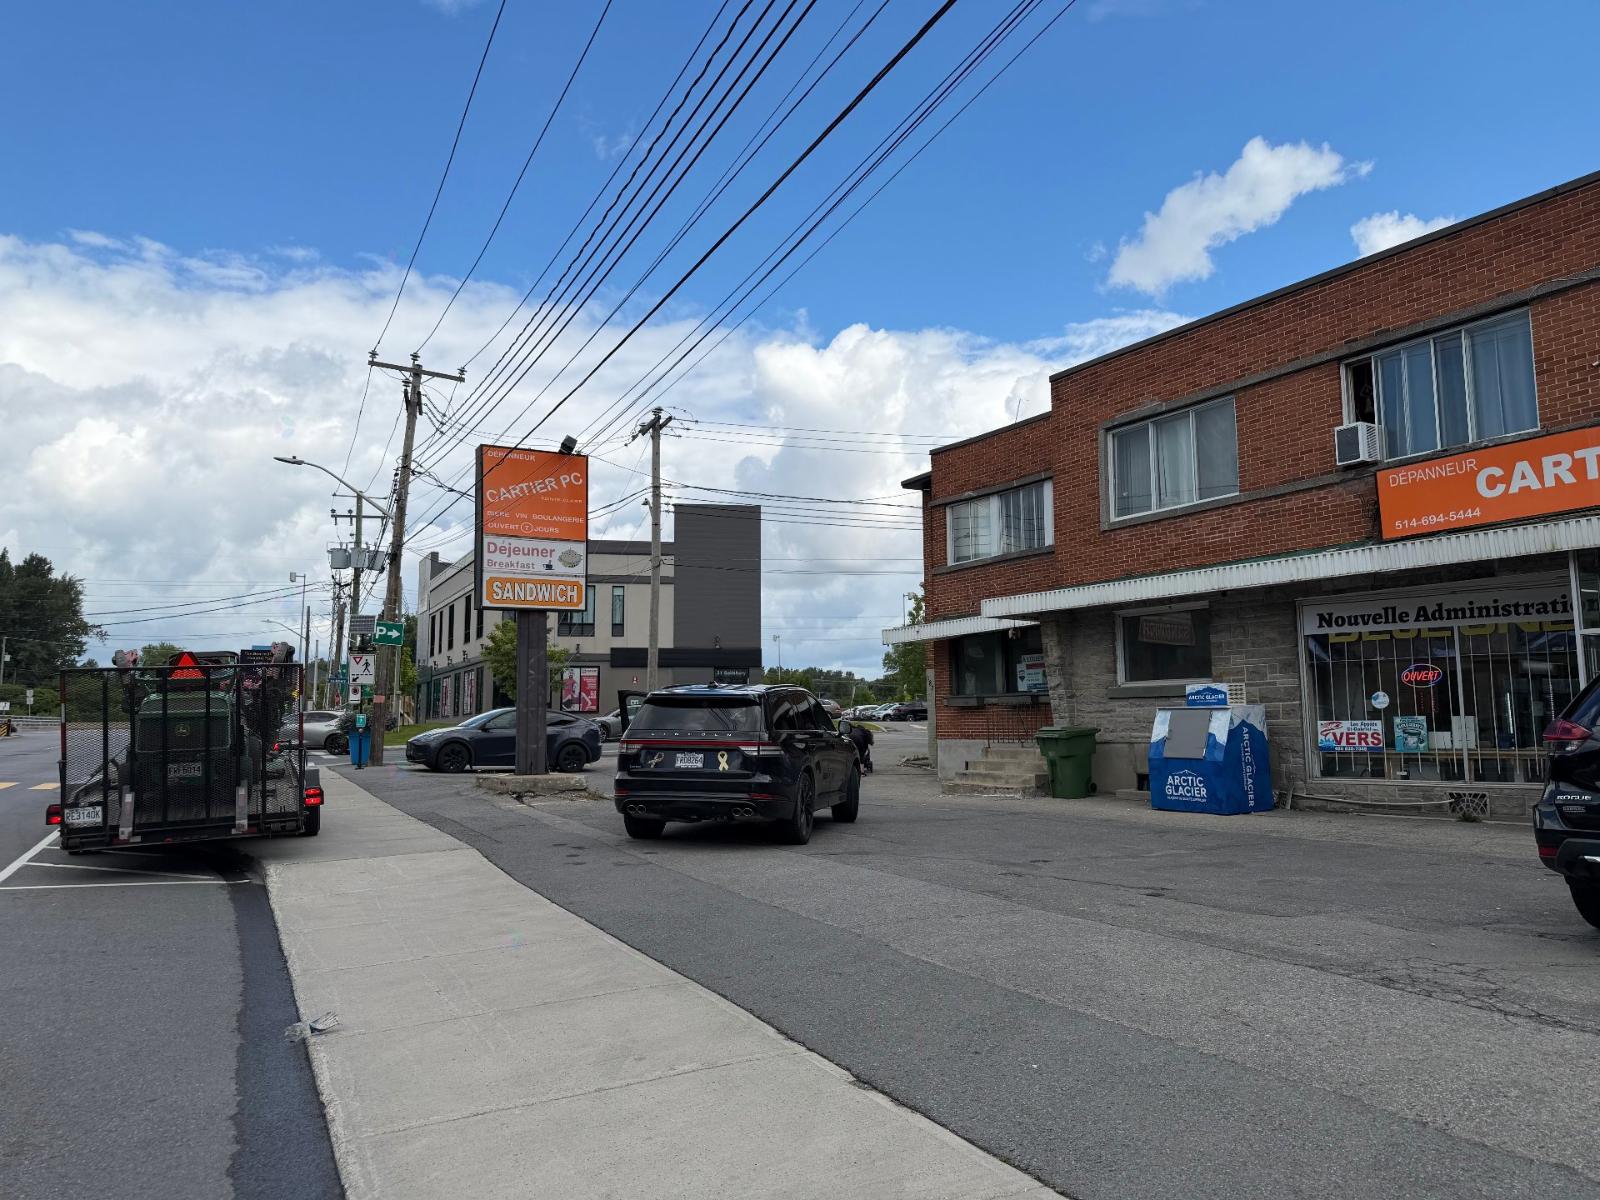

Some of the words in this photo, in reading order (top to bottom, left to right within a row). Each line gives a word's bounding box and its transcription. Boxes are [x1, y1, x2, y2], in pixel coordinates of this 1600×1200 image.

[1389, 458, 1478, 488] DÉPANNEUR
[1476, 446, 1600, 498] CART
[486, 477, 559, 503] CARTIER
[560, 472, 583, 488] PC
[488, 522, 519, 530] OUVERT
[532, 513, 585, 524] BOULANGERIE
[1395, 506, 1482, 530] 514-694-5444
[487, 558, 535, 570] Breakfast
[492, 580, 578, 603] SANDWICH
[1316, 605, 1410, 629] Nouvelle
[375, 626, 387, 639] P
[1403, 670, 1440, 682] OUVERT
[1242, 726, 1251, 763] ARCTIC
[1331, 731, 1382, 746] VERS
[1167, 775, 1204, 787] ARCTIC
[1246, 765, 1255, 807] GLACIER
[1165, 785, 1208, 798] GLACIER
